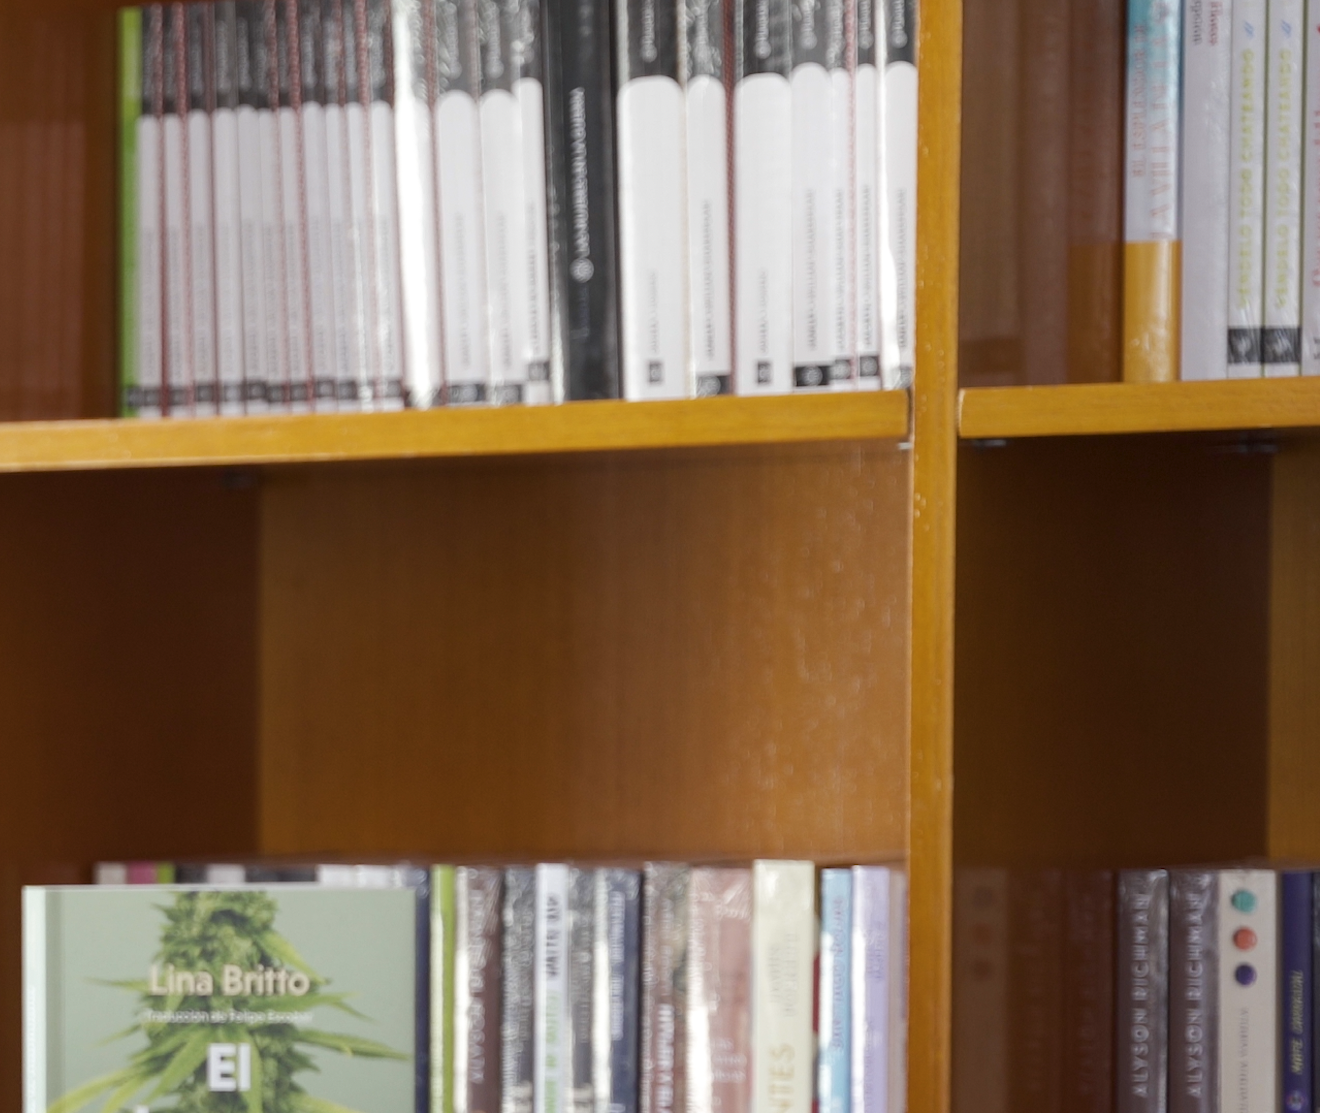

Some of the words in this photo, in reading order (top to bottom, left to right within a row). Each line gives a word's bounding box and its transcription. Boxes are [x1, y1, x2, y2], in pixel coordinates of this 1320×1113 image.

[148, 963, 212, 996] Lina
[222, 963, 311, 997] Britto
[1131, 893, 1150, 1001] RICHMAN
[1185, 893, 1205, 1001] RICHMAN
[207, 1043, 251, 1092] El
[1131, 1009, 1150, 1098] ALYSON
[1185, 1009, 1205, 1098] ALYSON
